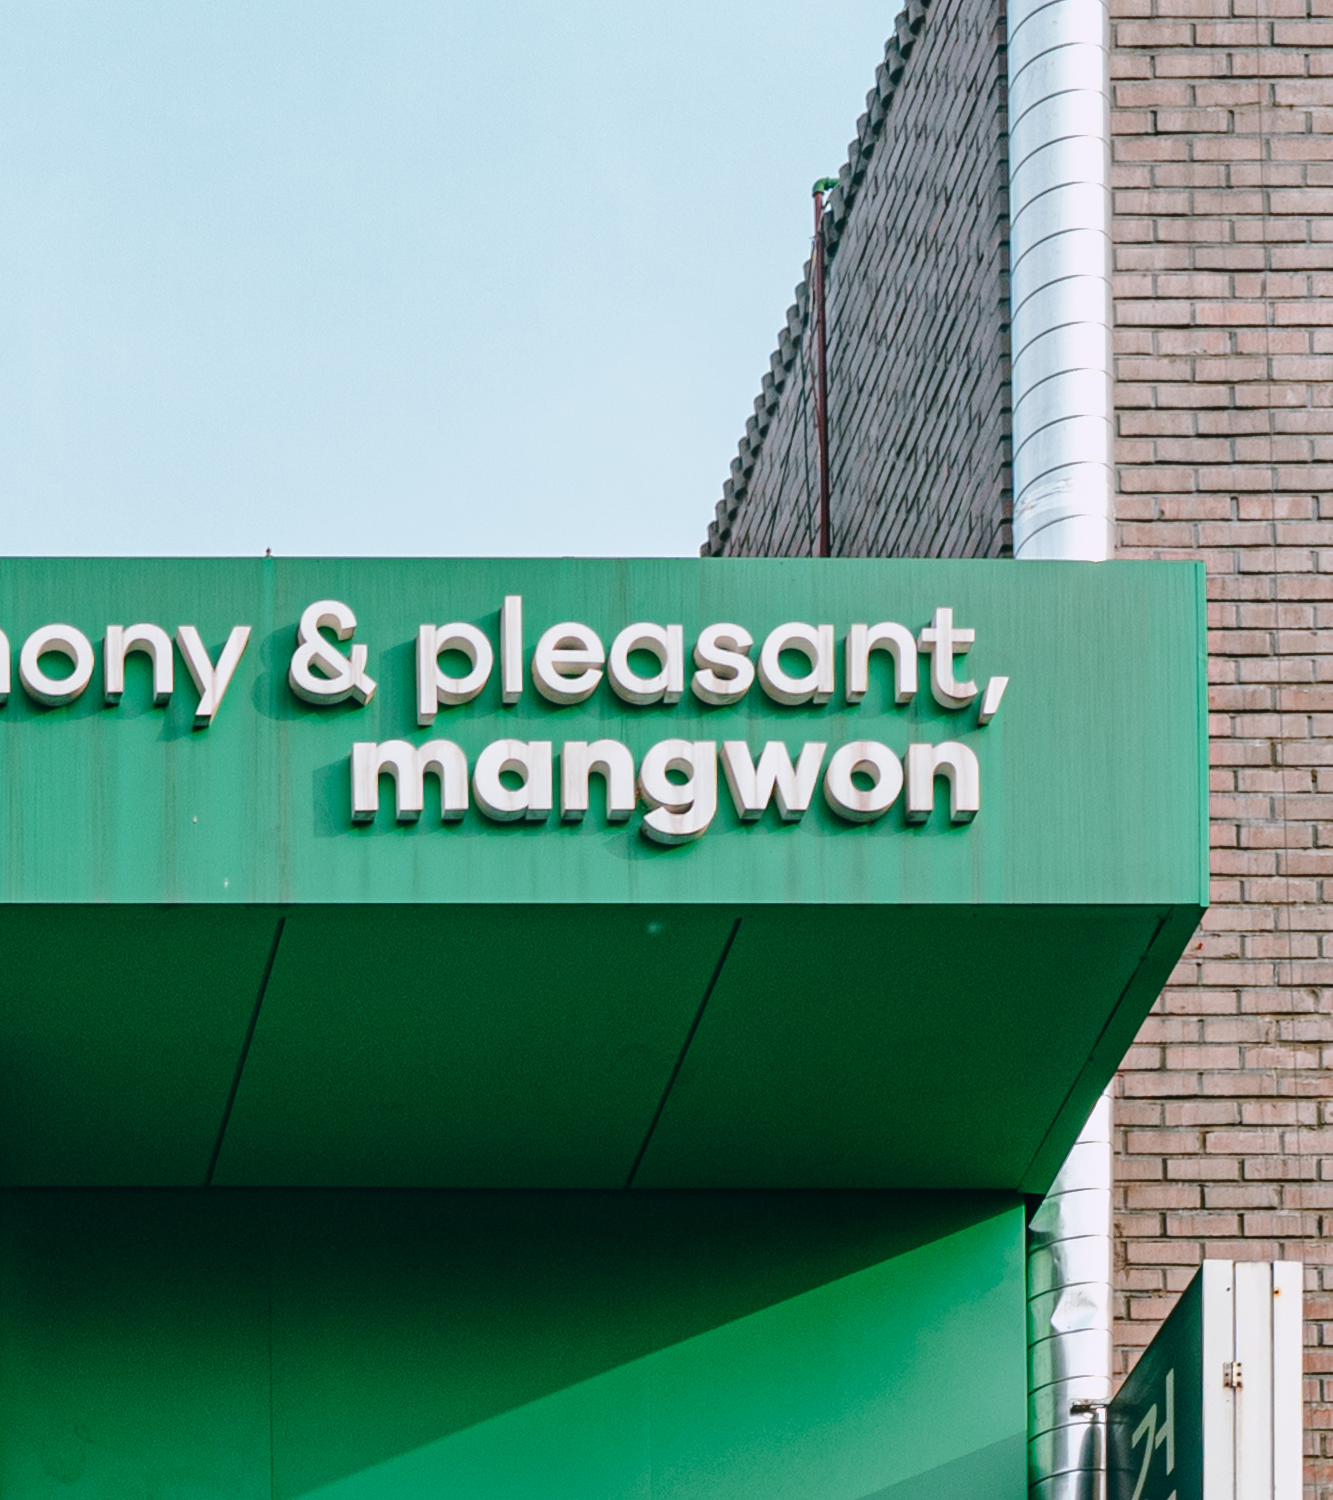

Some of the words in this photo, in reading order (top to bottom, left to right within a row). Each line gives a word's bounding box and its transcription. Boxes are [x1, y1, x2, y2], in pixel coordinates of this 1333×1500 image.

[288, 597, 376, 706] &
[416, 594, 1009, 726] pleasant,
[351, 737, 981, 845] mangwon
